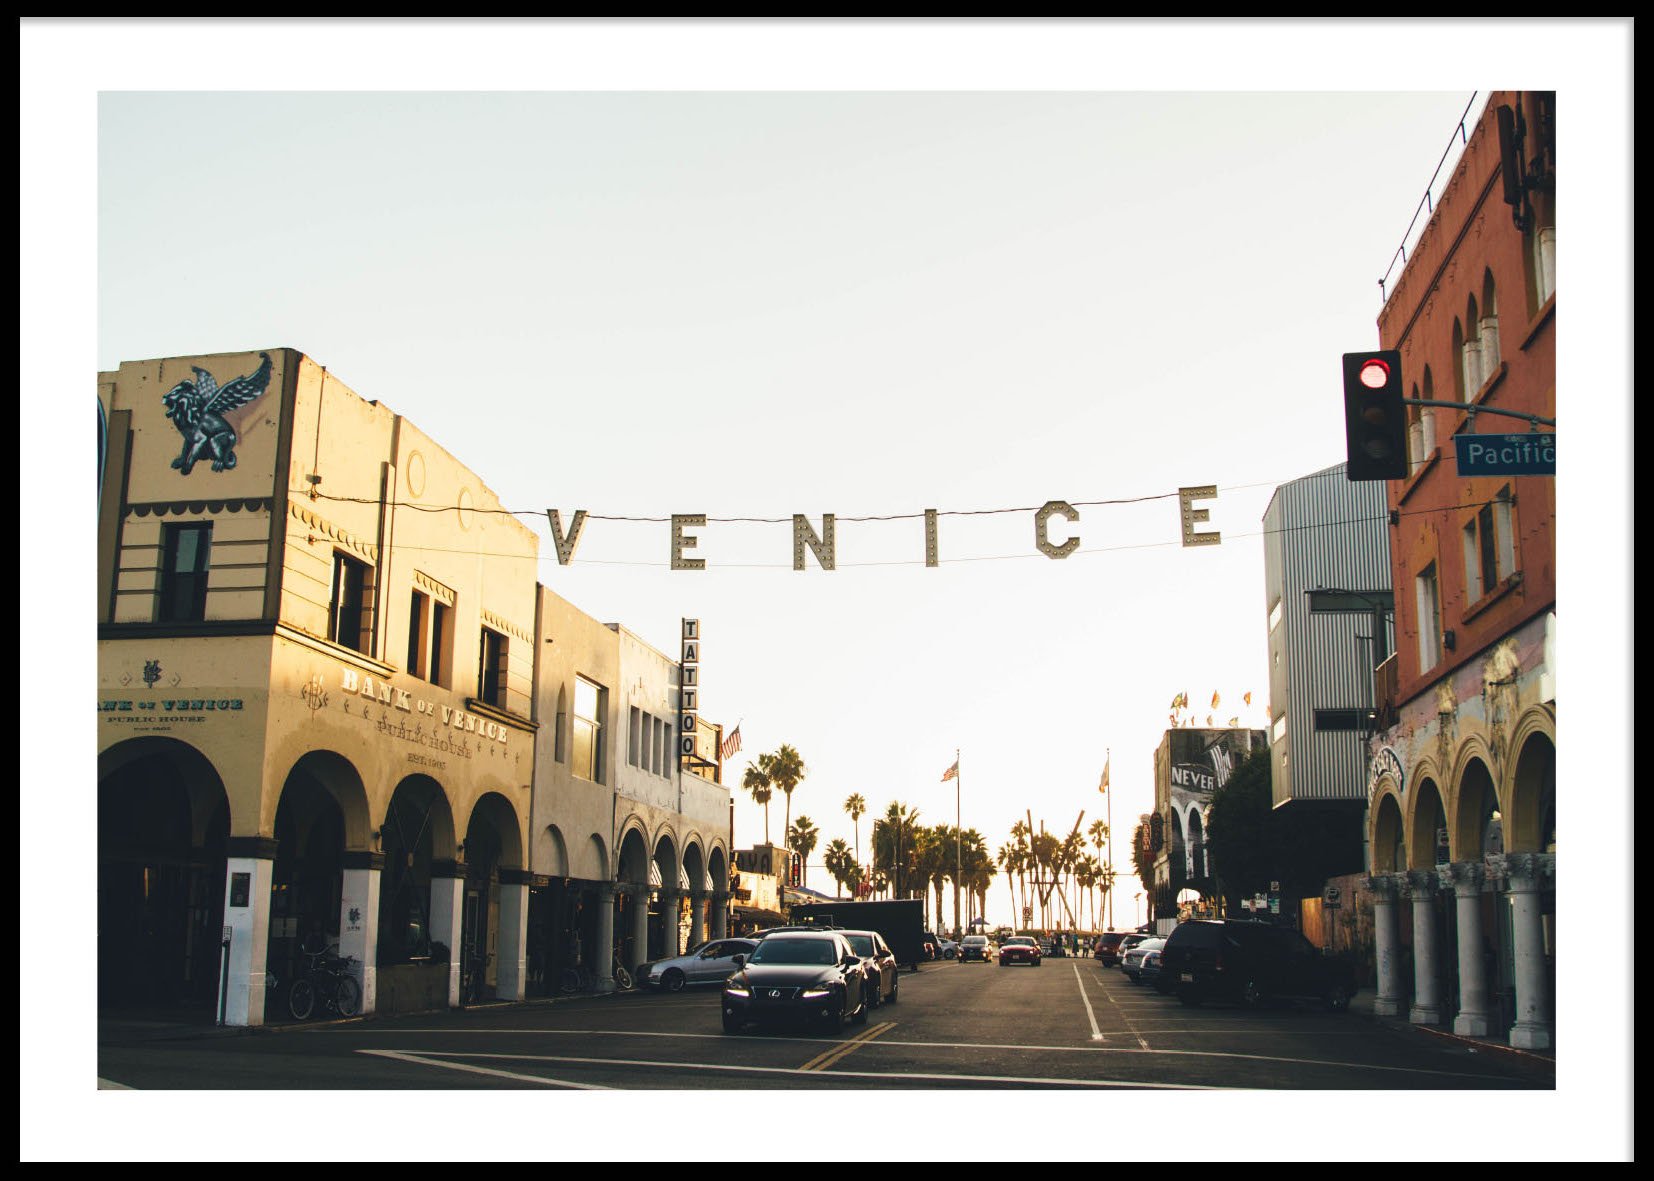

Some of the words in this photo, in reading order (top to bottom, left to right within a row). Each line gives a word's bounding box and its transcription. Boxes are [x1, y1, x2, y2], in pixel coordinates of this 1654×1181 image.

[1468, 443, 1555, 465] Pacific
[546, 485, 1221, 571] VENICE
[161, 699, 244, 711] VENICE
[342, 668, 411, 711] BANK
[417, 700, 434, 716] OF
[442, 704, 508, 743] VENICE
[683, 621, 696, 753] TATTOO
[377, 721, 427, 745] PUBLIC
[430, 738, 473, 759] HOUSE
[1171, 767, 1214, 790] NEVER
